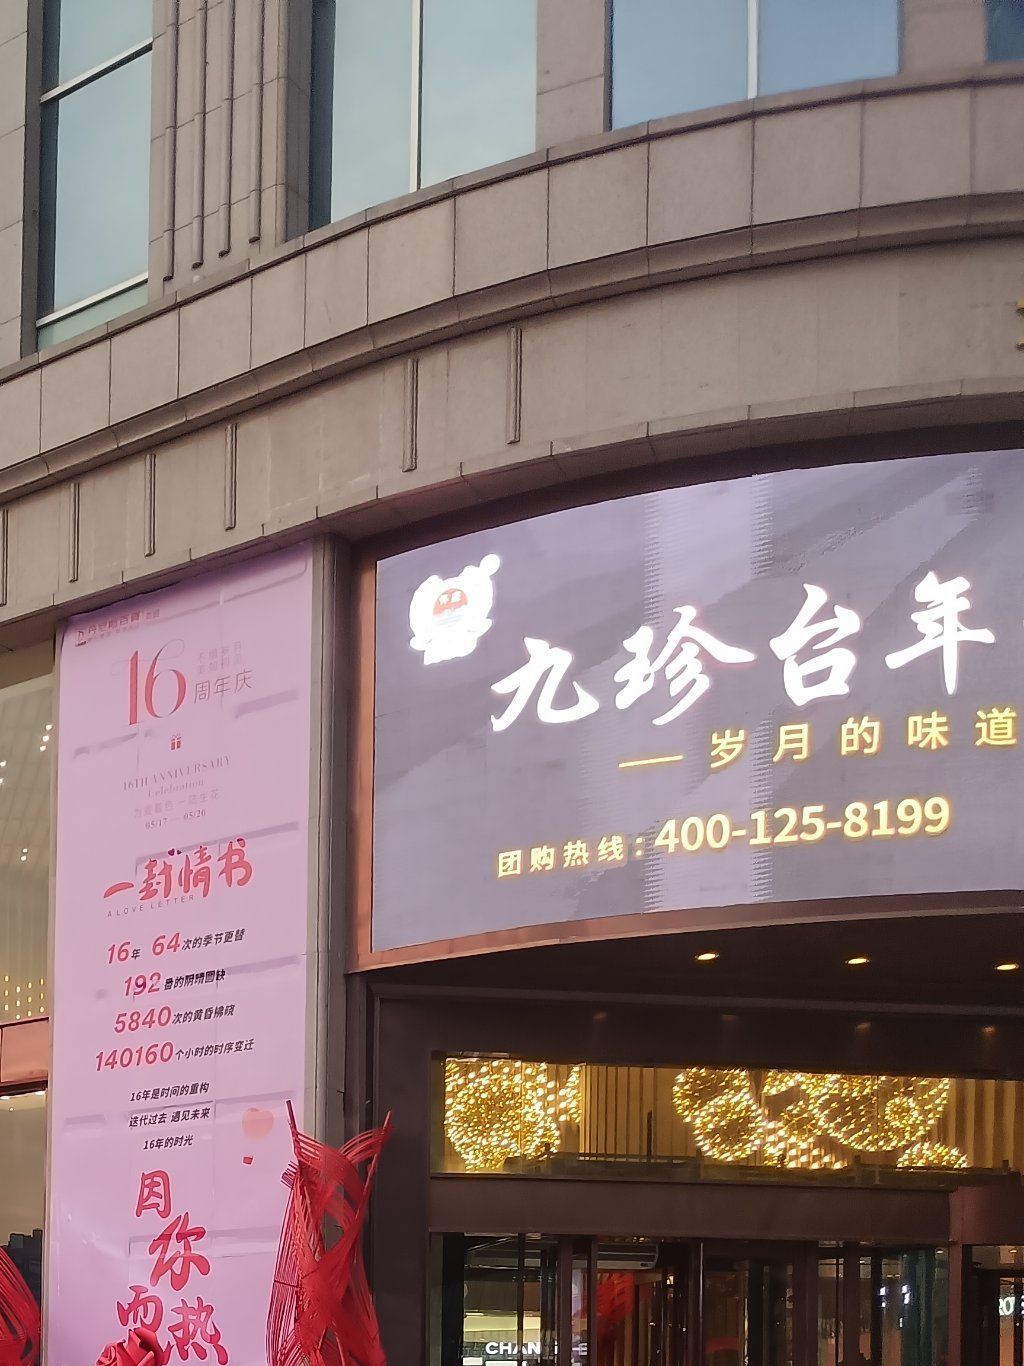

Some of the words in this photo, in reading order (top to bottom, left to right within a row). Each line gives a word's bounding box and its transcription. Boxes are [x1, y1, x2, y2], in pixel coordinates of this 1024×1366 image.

[490, 570, 995, 731] 九珍台年
[128, 639, 187, 726] 16
[193, 669, 252, 704] 周年庆
[655, 796, 951, 853] 400-125-8199
[103, 838, 253, 901] 一封情书
